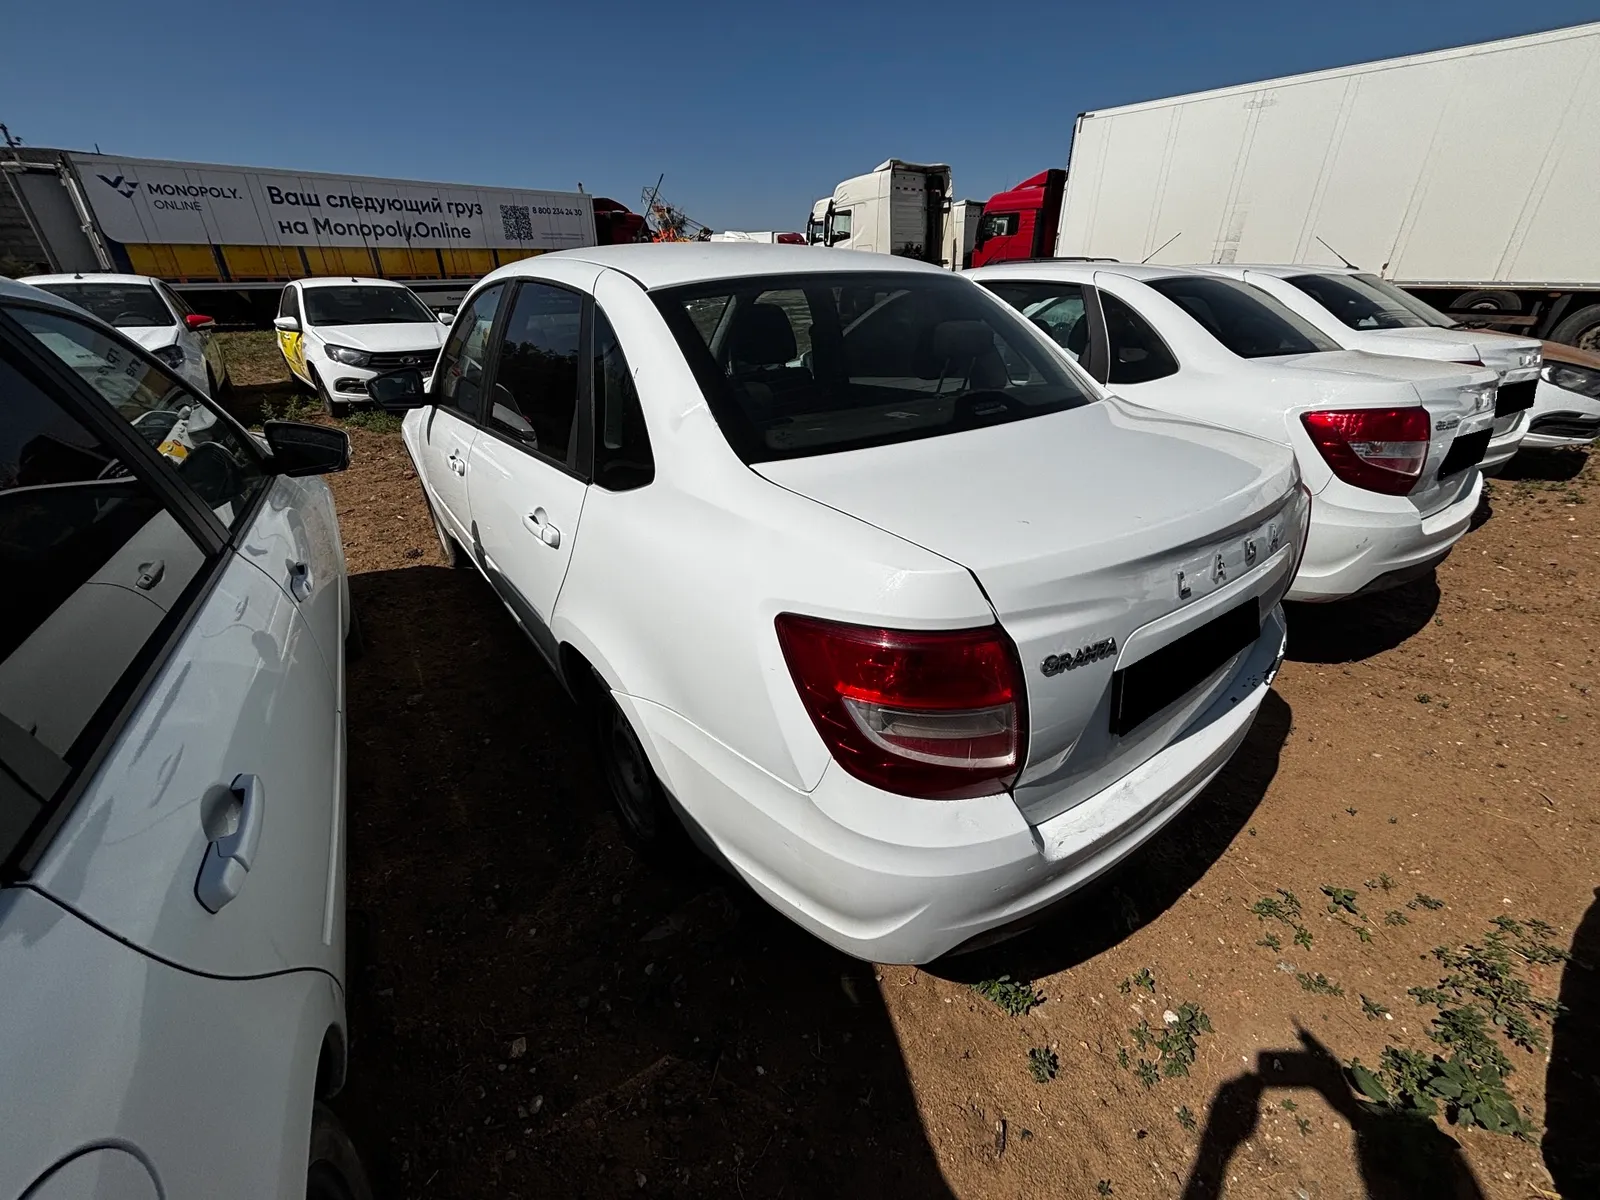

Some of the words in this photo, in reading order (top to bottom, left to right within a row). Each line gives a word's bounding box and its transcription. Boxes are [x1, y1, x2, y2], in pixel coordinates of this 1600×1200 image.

[147, 183, 243, 200] MONOPOLY.
[267, 185, 321, 207] Ваш
[326, 193, 443, 216] следующий
[447, 201, 484, 219] груз
[154, 199, 203, 212] ONLINE
[532, 206, 538, 215] 8
[538, 207, 552, 215] 800
[552, 207, 565, 216] 234
[565, 208, 574, 216] 24
[574, 208, 583, 217] 30
[278, 220, 309, 235] на
[313, 217, 472, 241] Monopoly.Online
[1177, 522, 1280, 601] LADA
[1040, 636, 1118, 678] GRANTA
